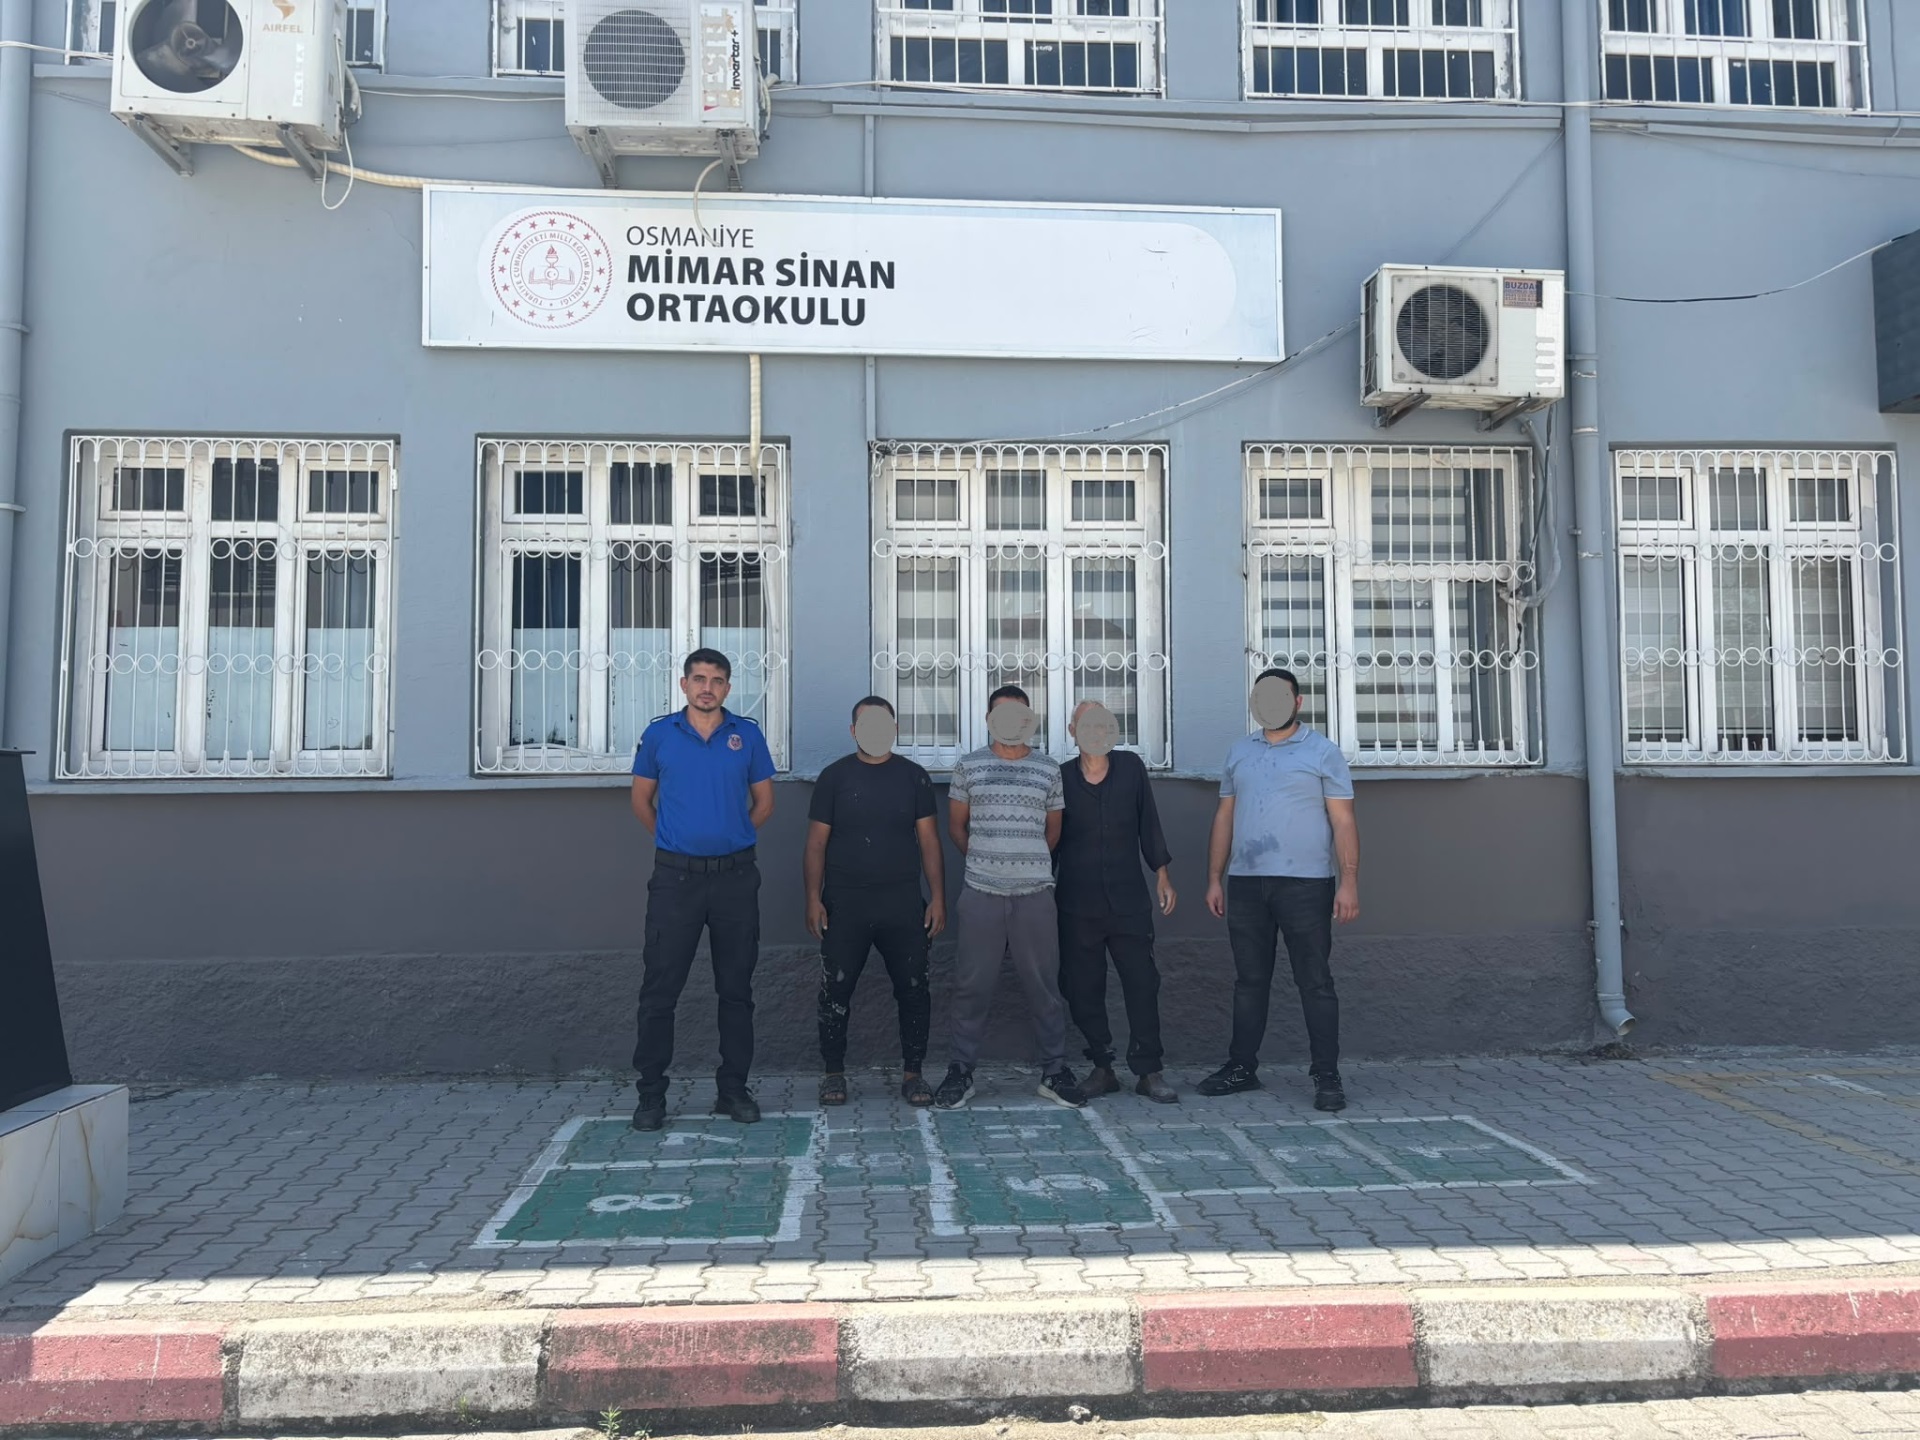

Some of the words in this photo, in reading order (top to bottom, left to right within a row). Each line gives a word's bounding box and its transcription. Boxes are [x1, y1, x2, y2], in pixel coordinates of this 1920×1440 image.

[263, 23, 304, 33] AIRFEL
[626, 225, 754, 248] OSMANİYE
[627, 248, 765, 286] MİMAR
[775, 251, 895, 289] SİNAN
[1505, 281, 1537, 290] BUZDA
[626, 292, 866, 326] ORTAOKULU
[586, 1193, 694, 1213] 8
